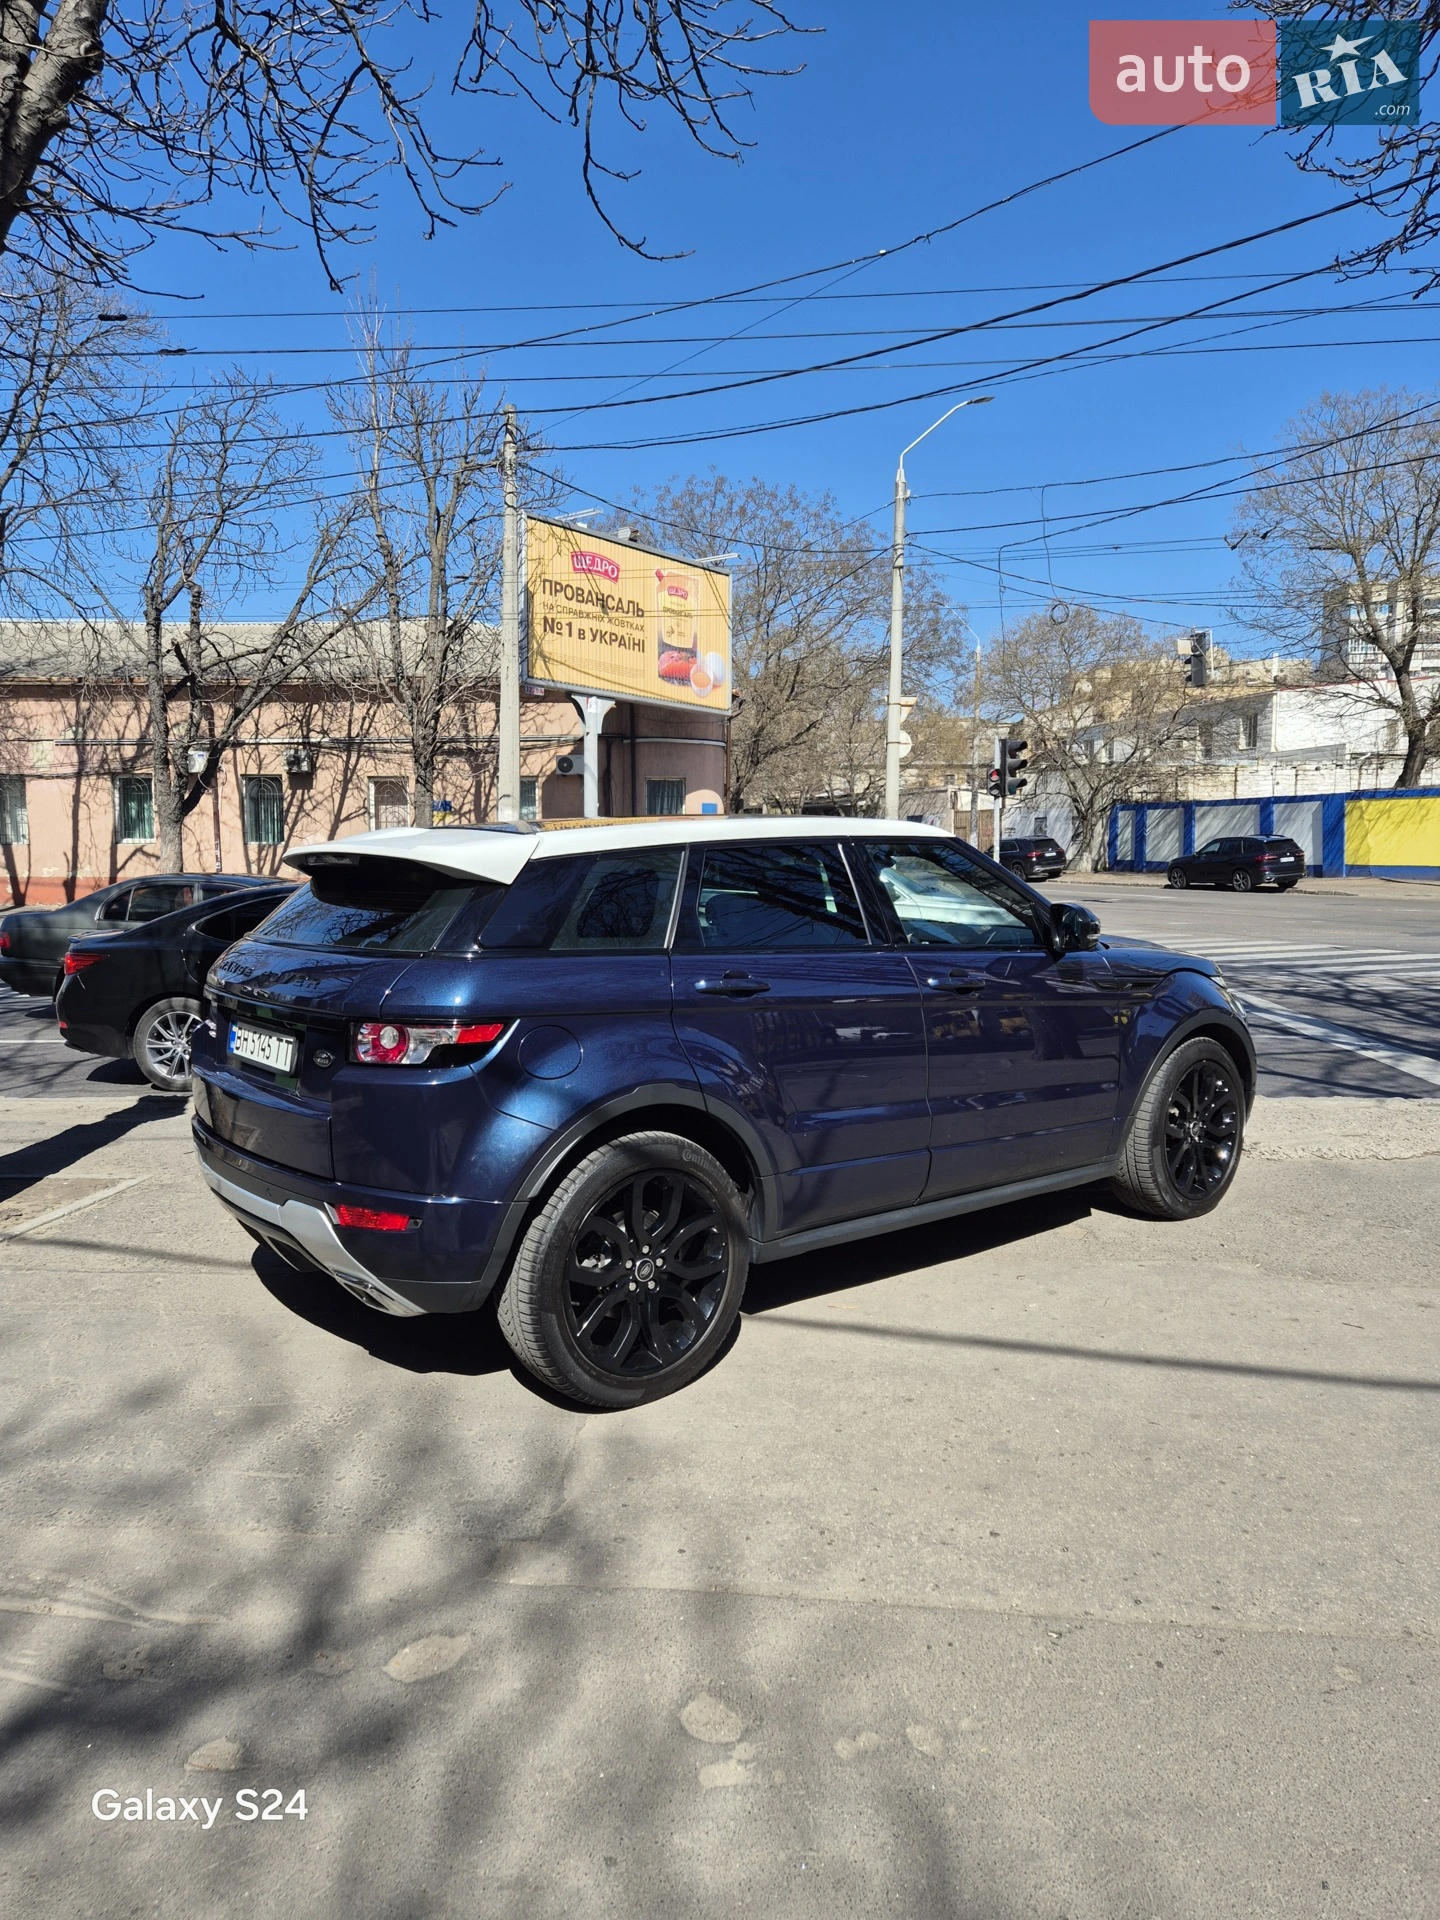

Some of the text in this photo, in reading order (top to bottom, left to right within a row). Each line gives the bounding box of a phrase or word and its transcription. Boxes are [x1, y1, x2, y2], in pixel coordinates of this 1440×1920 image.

[573, 555, 618, 578] ЩЕДРО
[542, 578, 645, 618] ПРОВАНСАЛЬ
[543, 601, 645, 633] НА СПРАВЖНІХ ЖОВТКАХ
[589, 627, 645, 653] УКРАЇНІ
[220, 961, 254, 978] RANGE
